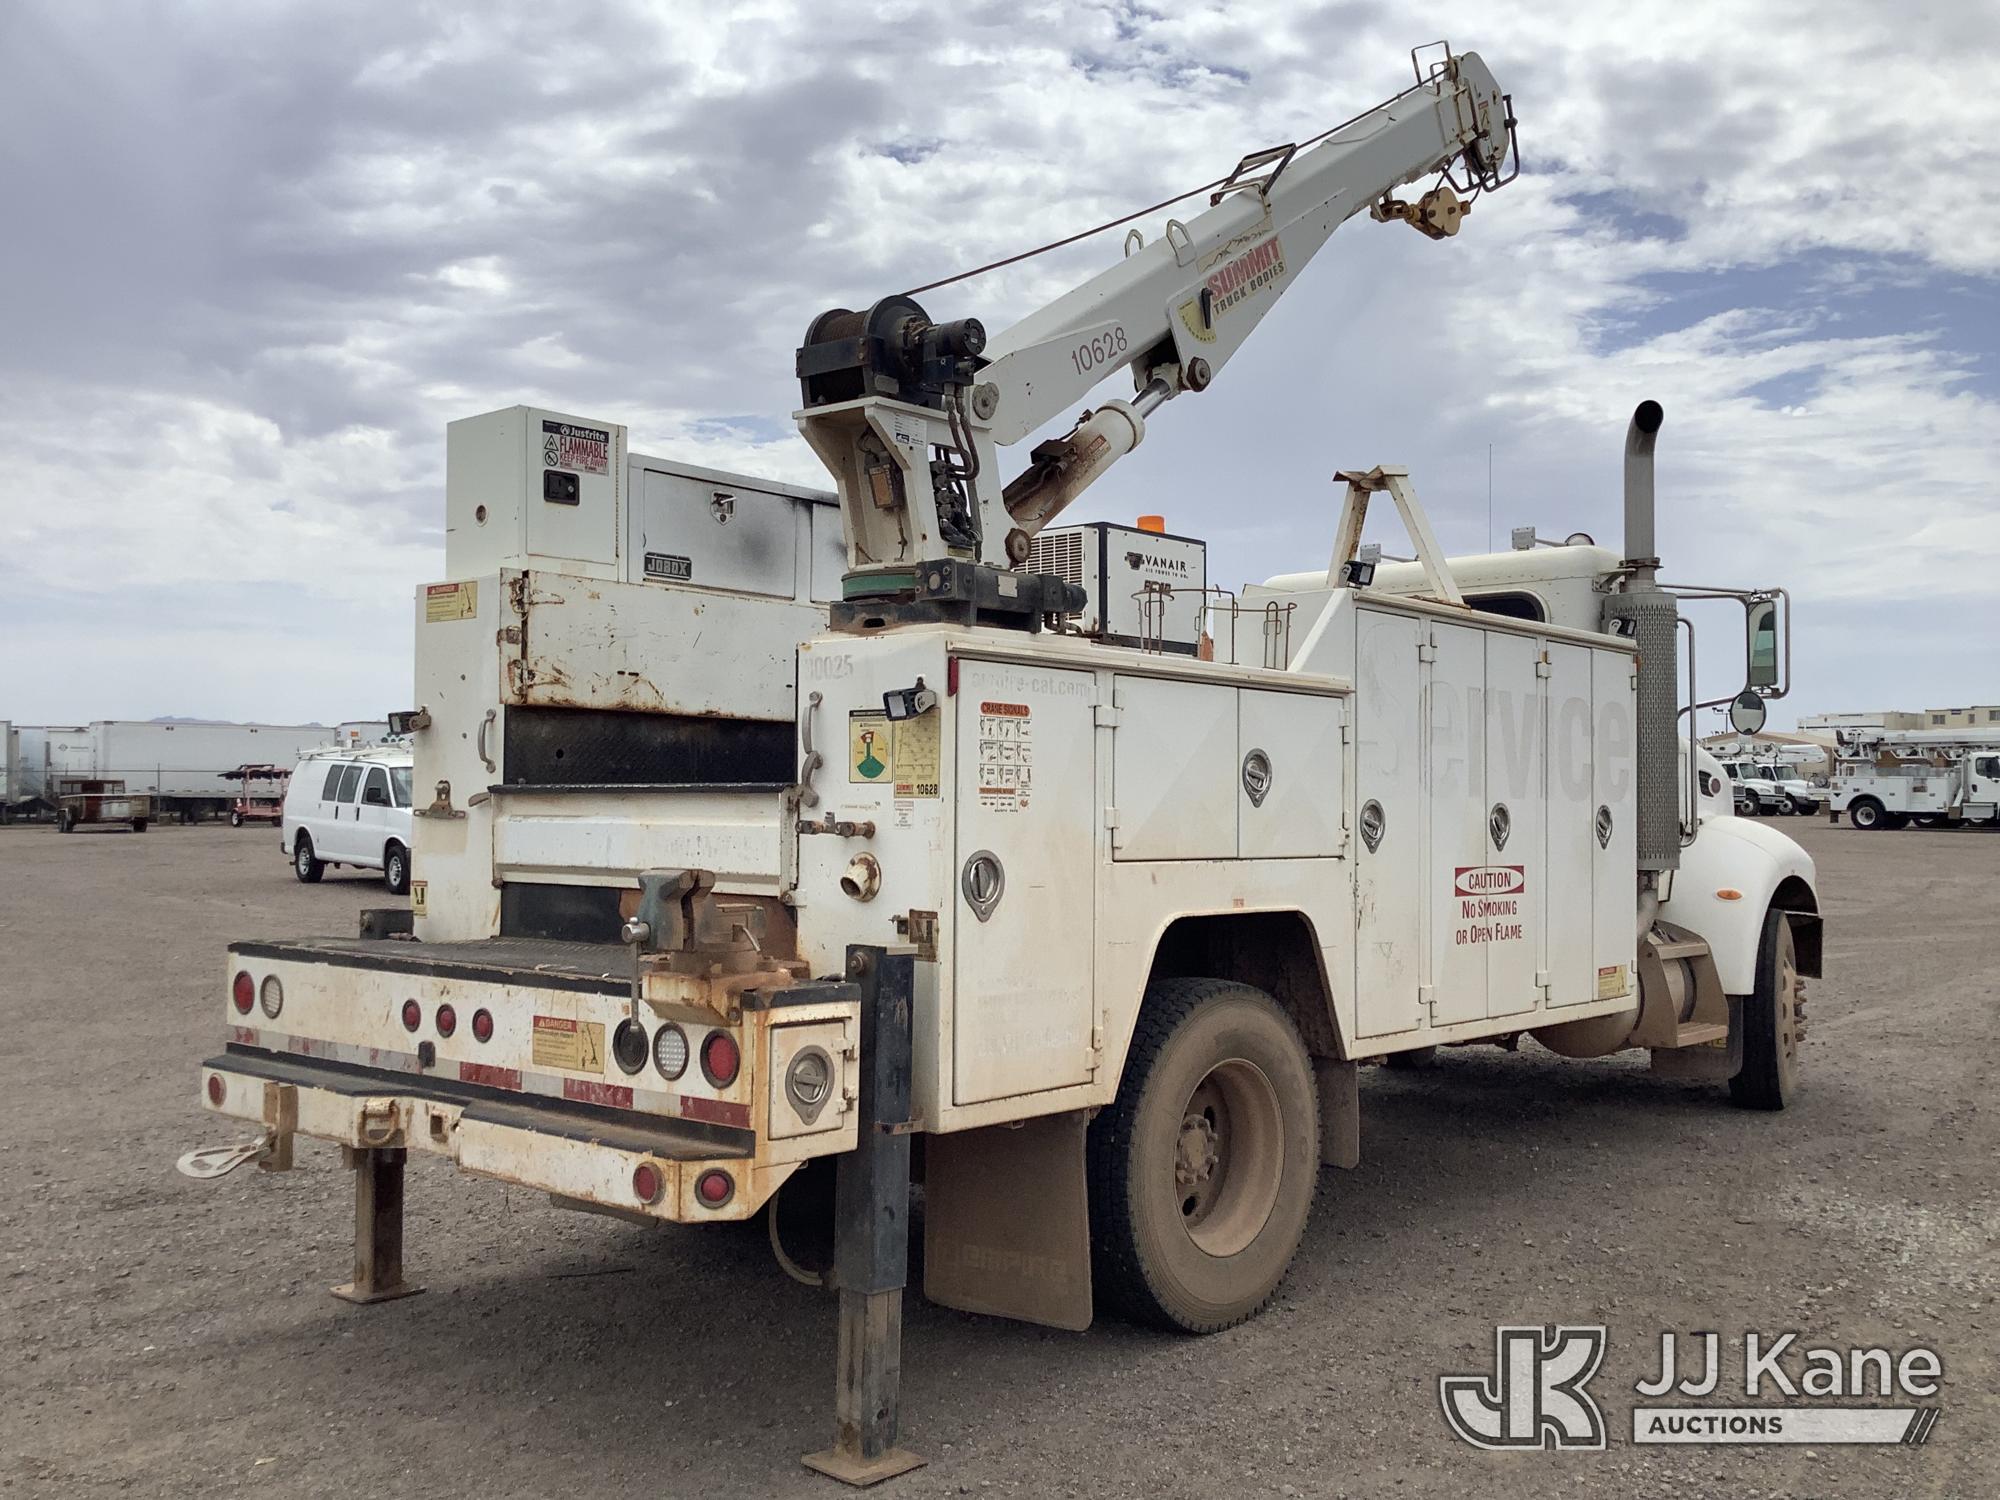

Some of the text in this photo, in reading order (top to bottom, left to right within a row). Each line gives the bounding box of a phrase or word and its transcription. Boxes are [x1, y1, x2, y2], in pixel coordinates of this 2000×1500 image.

[1207, 236, 1280, 301] SUMMIT
[1213, 261, 1284, 315] TRUCK BODIES
[1071, 327, 1128, 375] 10628
[570, 427, 606, 442] Justrite
[560, 436, 608, 460] FLAMMABLE
[576, 456, 588, 466] FIRE
[647, 557, 688, 576] JOBOX
[1145, 554, 1187, 572] VANAIR
[982, 703, 1029, 717] CRANE SIGNALS
[916, 783, 938, 795] 10628
[1469, 872, 1511, 889] CAUTION
